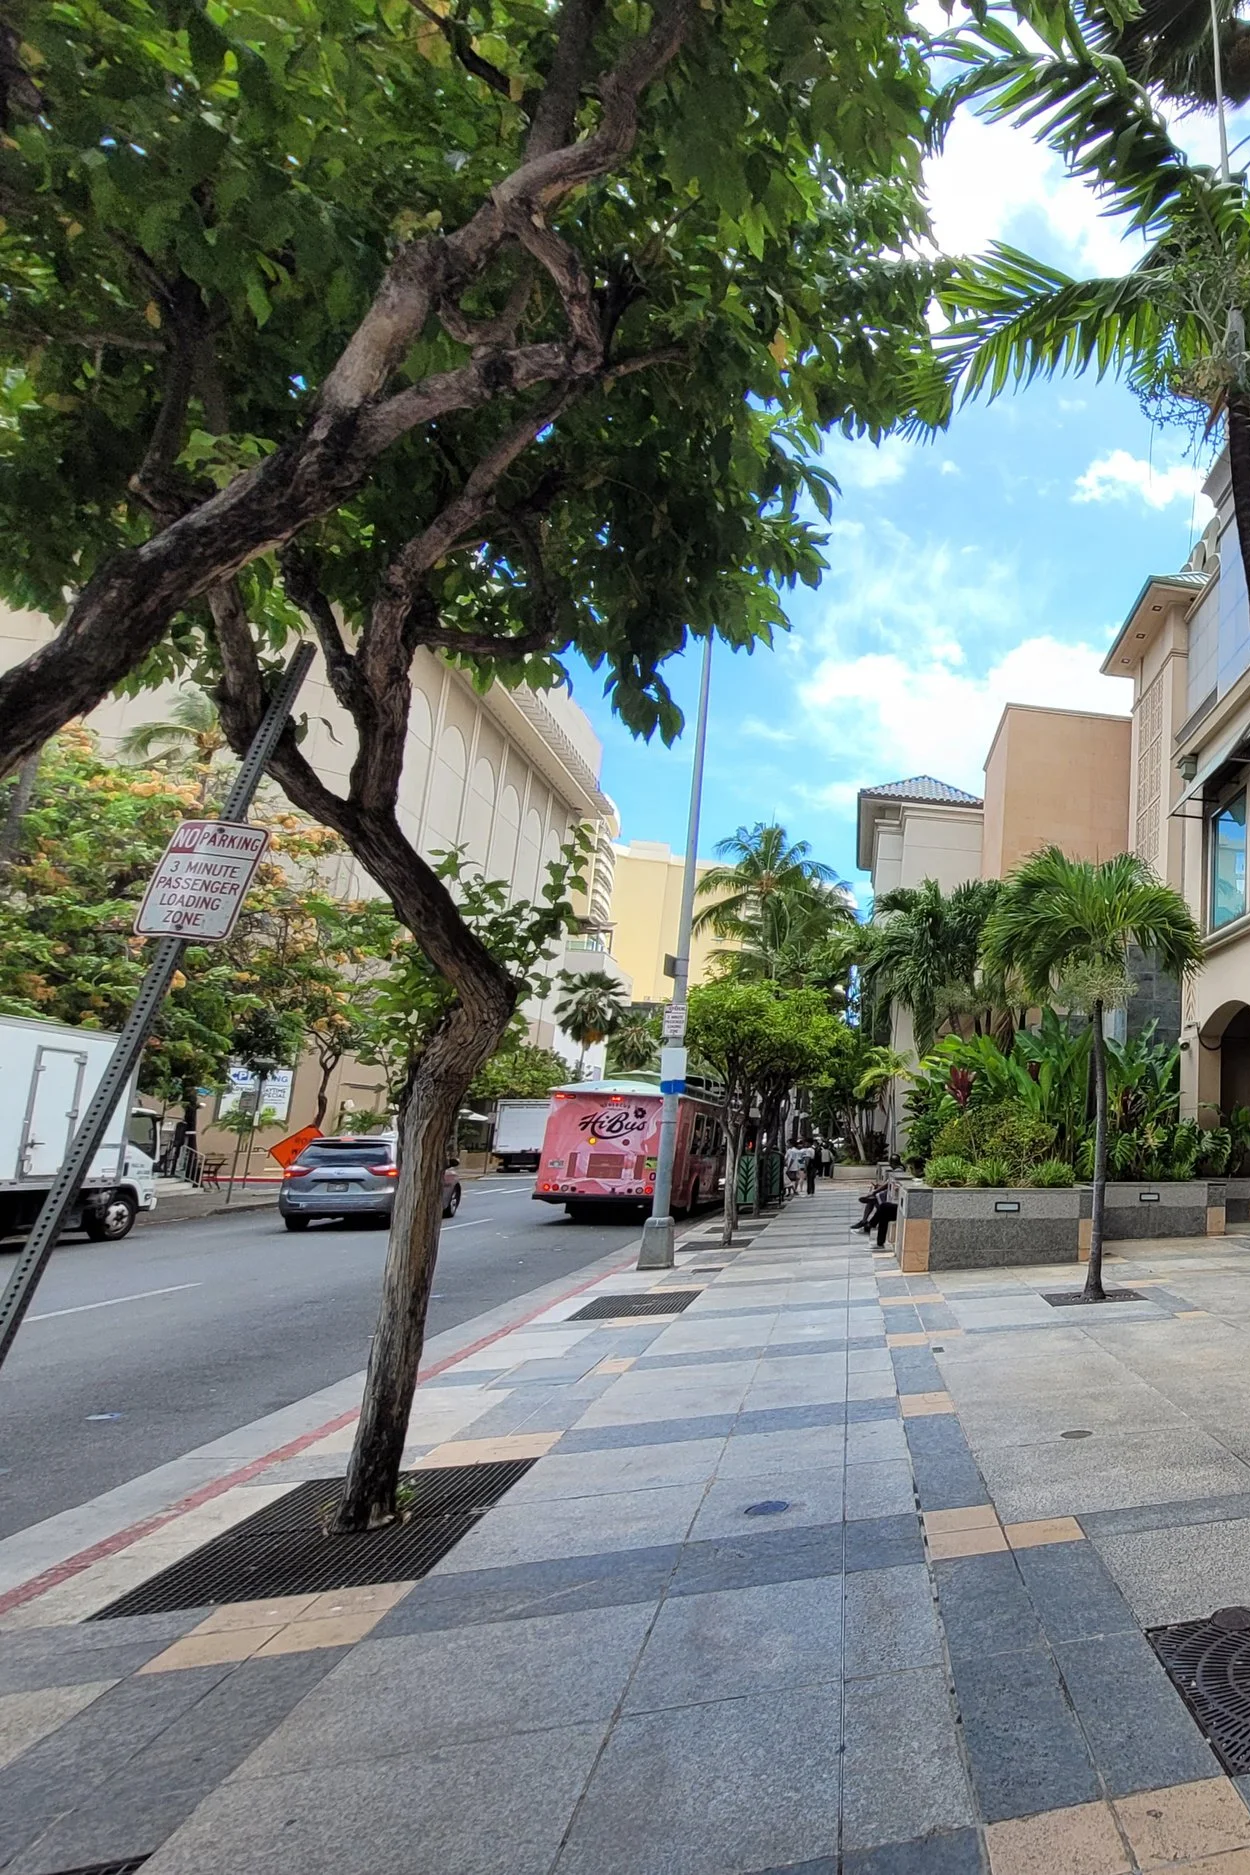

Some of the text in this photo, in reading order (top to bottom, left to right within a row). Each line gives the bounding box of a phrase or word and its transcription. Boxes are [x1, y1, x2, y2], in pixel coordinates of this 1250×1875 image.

[172, 828, 261, 852] NO PARKING
[170, 860, 240, 879] 3 MINUTE
[156, 876, 240, 896] PASSENGER
[159, 893, 222, 911] LOADING
[162, 910, 205, 926] ZONE
